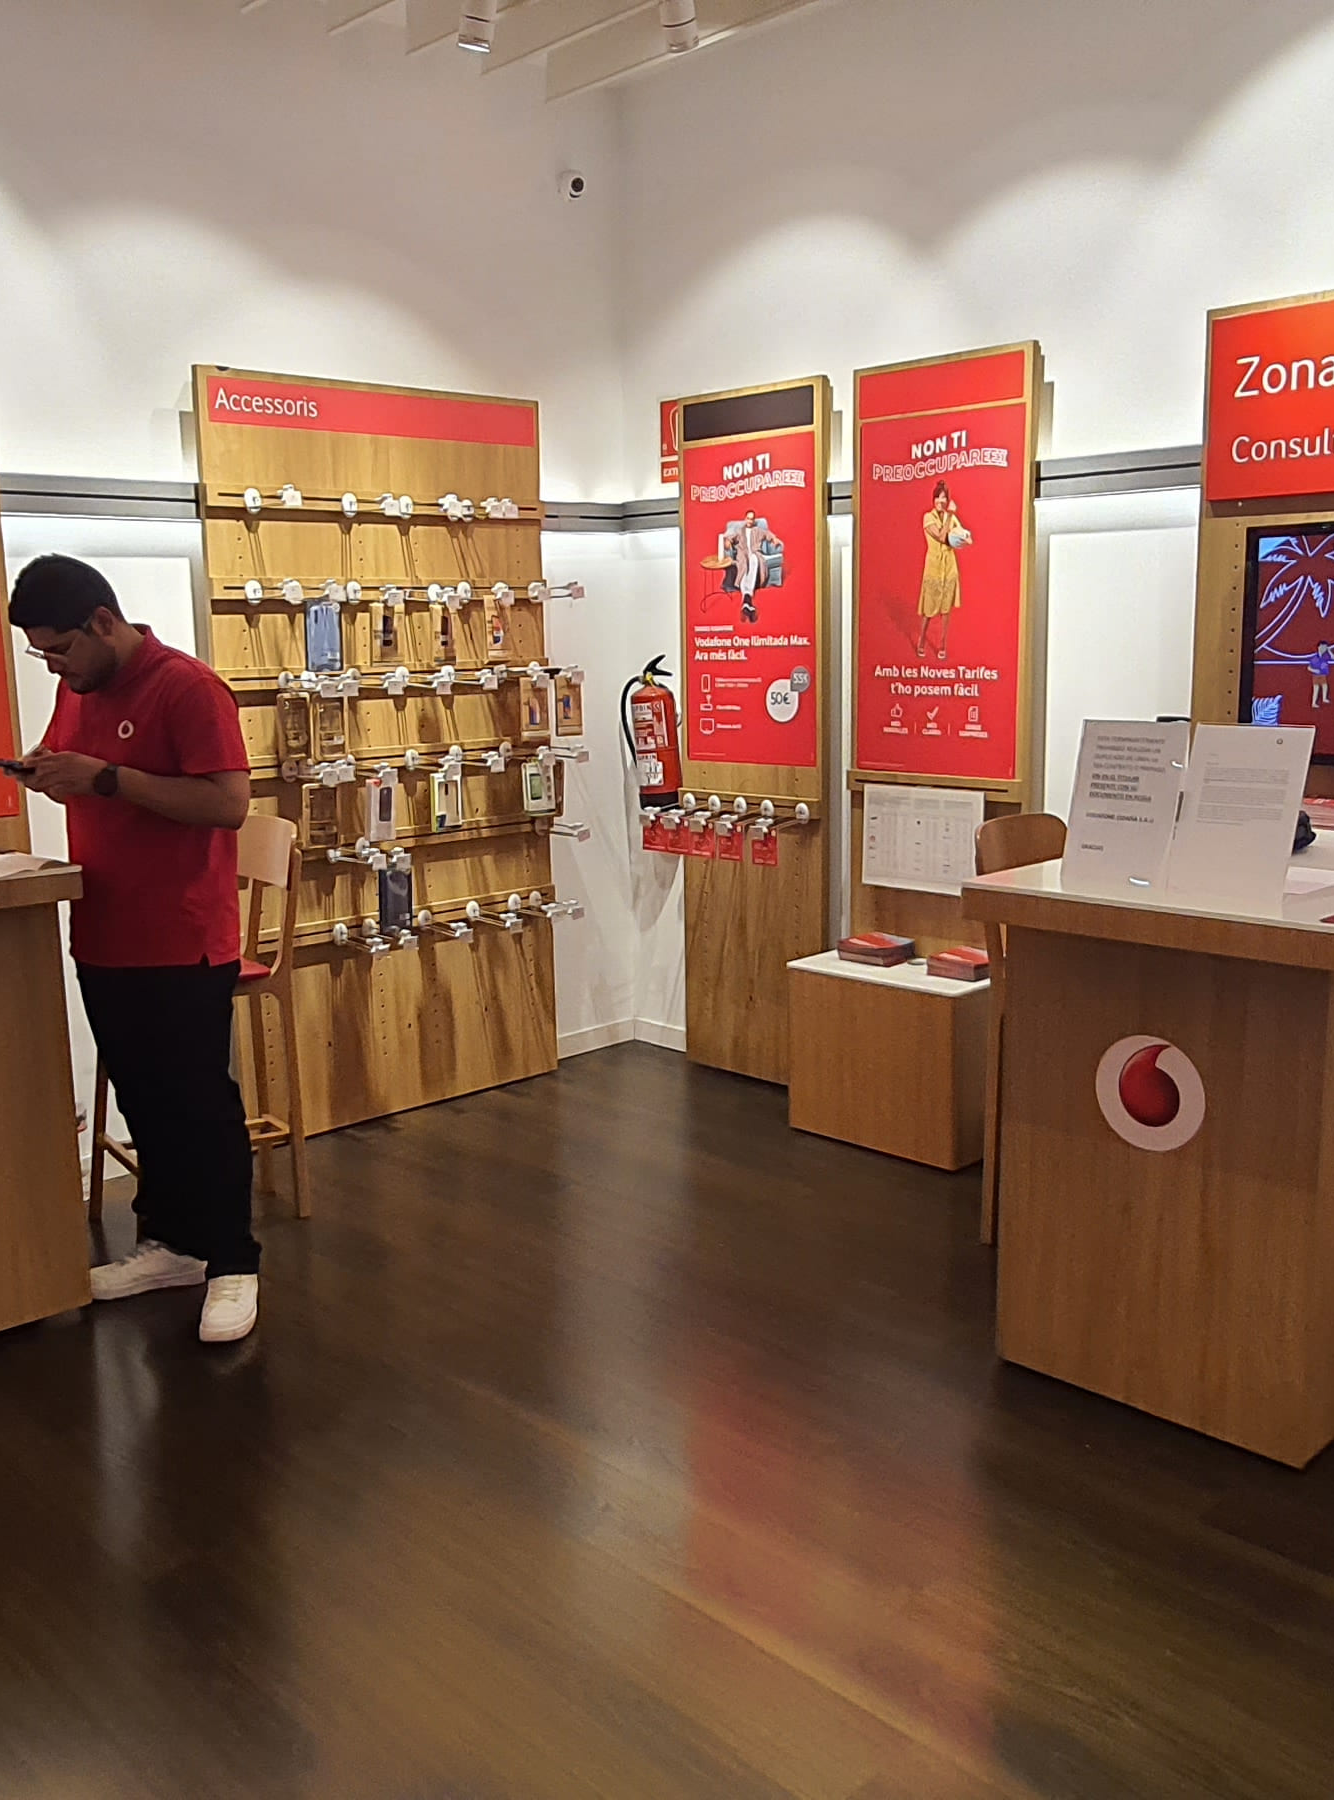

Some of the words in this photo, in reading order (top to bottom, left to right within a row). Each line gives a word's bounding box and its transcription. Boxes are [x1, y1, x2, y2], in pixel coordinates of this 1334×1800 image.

[214, 387, 318, 418] Accessoris
[911, 436, 947, 459] NON
[951, 430, 967, 448] TI
[722, 457, 753, 480] NON
[756, 453, 771, 469] TI
[694, 636, 732, 647] Vodafone
[732, 635, 750, 646] One
[694, 650, 709, 660] Ara
[709, 649, 727, 660] més
[874, 664, 900, 677] Amb
[901, 664, 918, 678] les
[920, 666, 956, 679] Noves
[957, 665, 998, 680] Tarifes
[770, 691, 791, 705] 50€
[913, 685, 951, 698] posem
